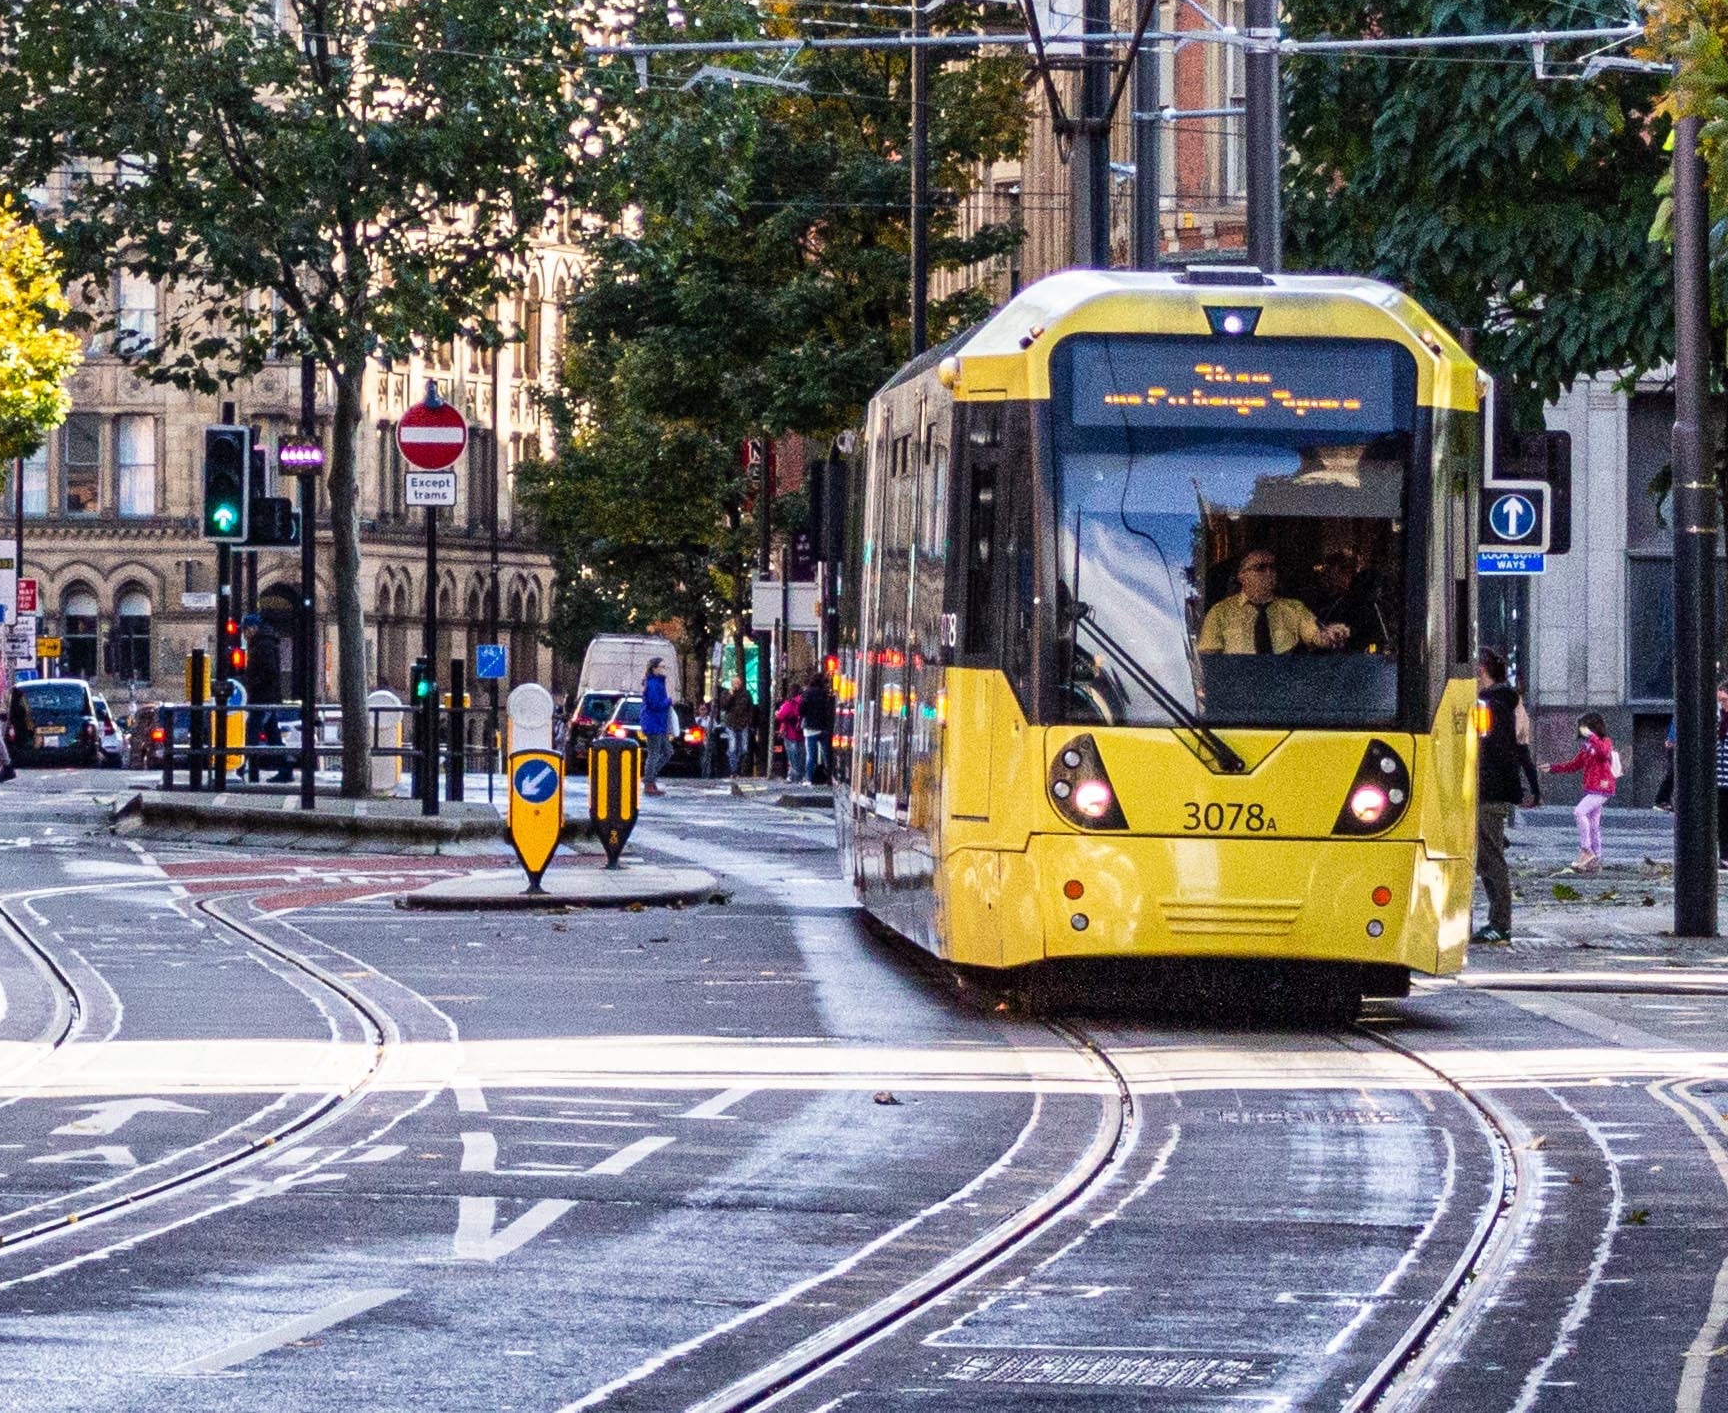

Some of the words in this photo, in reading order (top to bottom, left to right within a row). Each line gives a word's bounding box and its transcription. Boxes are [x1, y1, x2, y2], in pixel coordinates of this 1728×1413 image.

[410, 477, 451, 489] Except
[414, 490, 448, 500] trams
[1496, 560, 1526, 569] WAYS
[1183, 802, 1277, 832] 3078A
